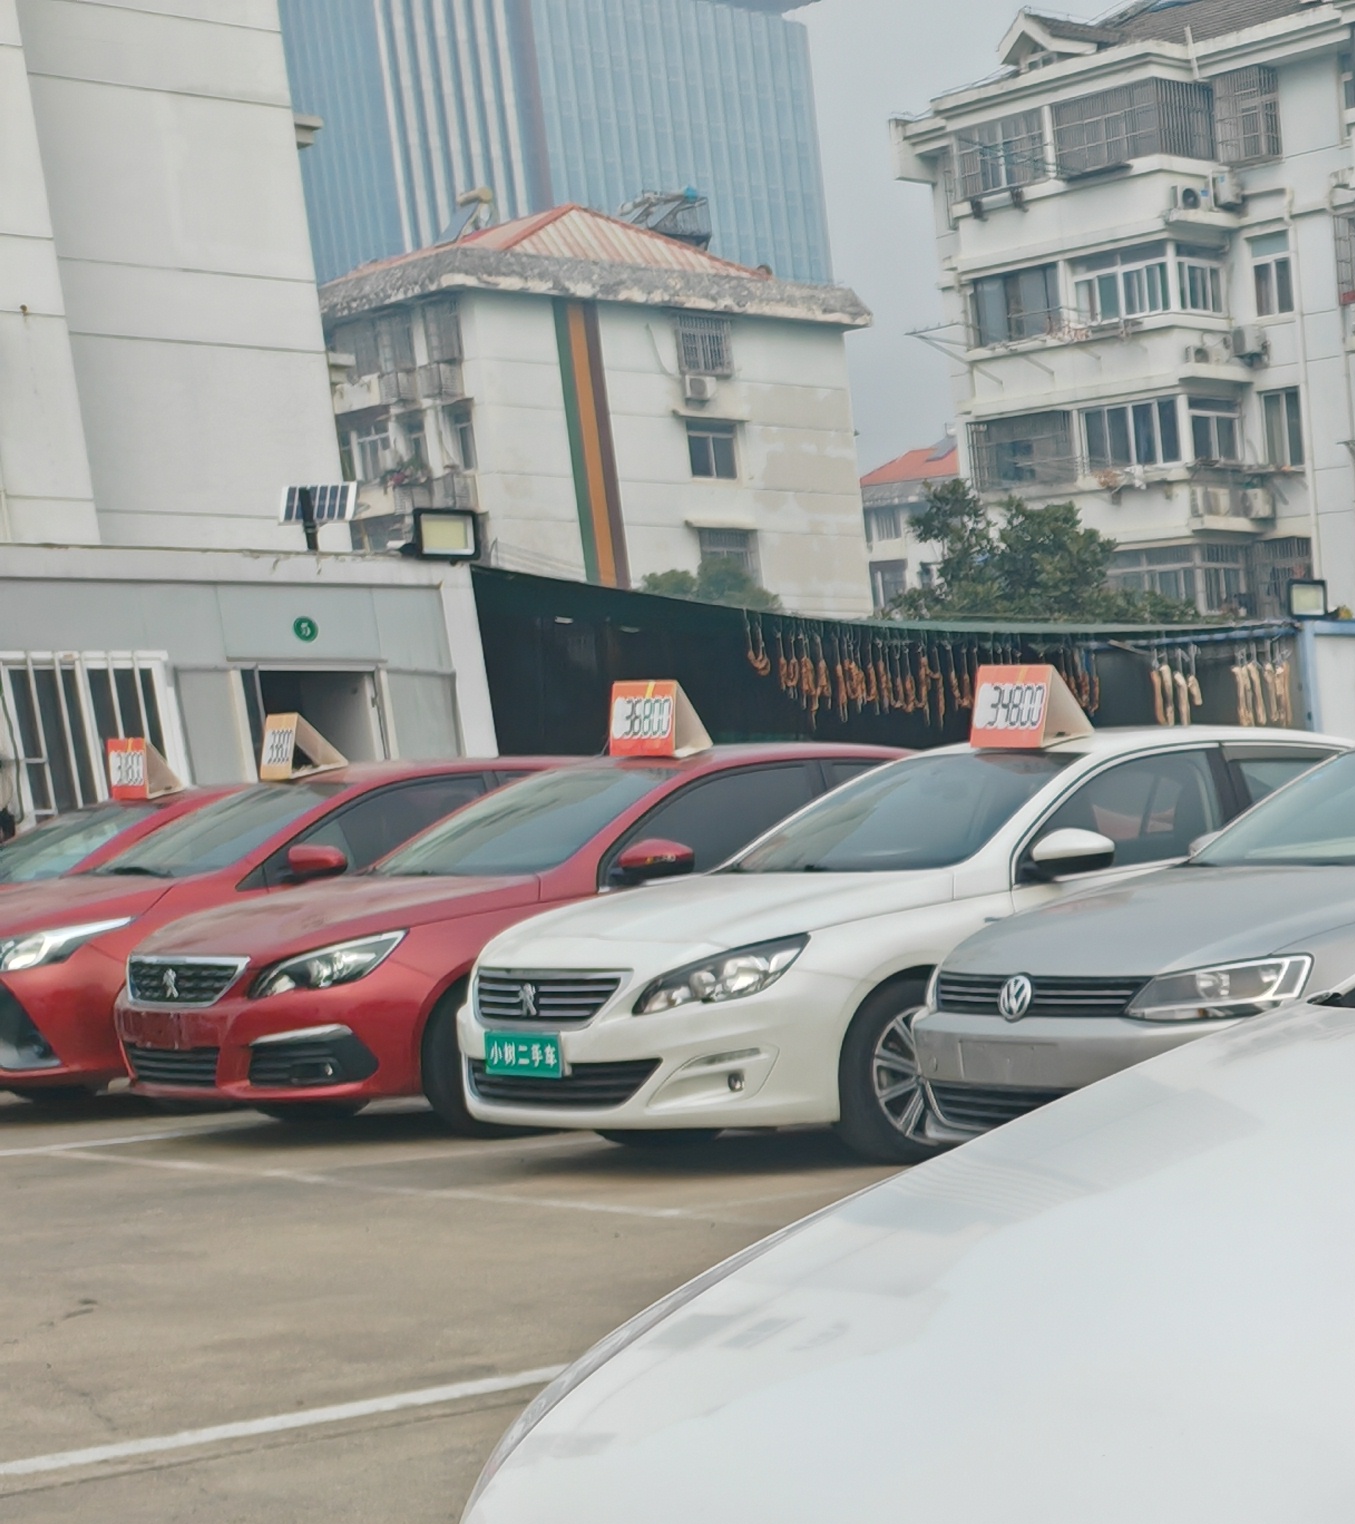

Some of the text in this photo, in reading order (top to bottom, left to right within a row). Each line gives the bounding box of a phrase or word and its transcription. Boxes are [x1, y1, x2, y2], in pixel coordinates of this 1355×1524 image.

[623, 698, 671, 736] 36800
[987, 685, 1045, 727] 34800
[489, 1040, 558, 1069] 小树二手车
